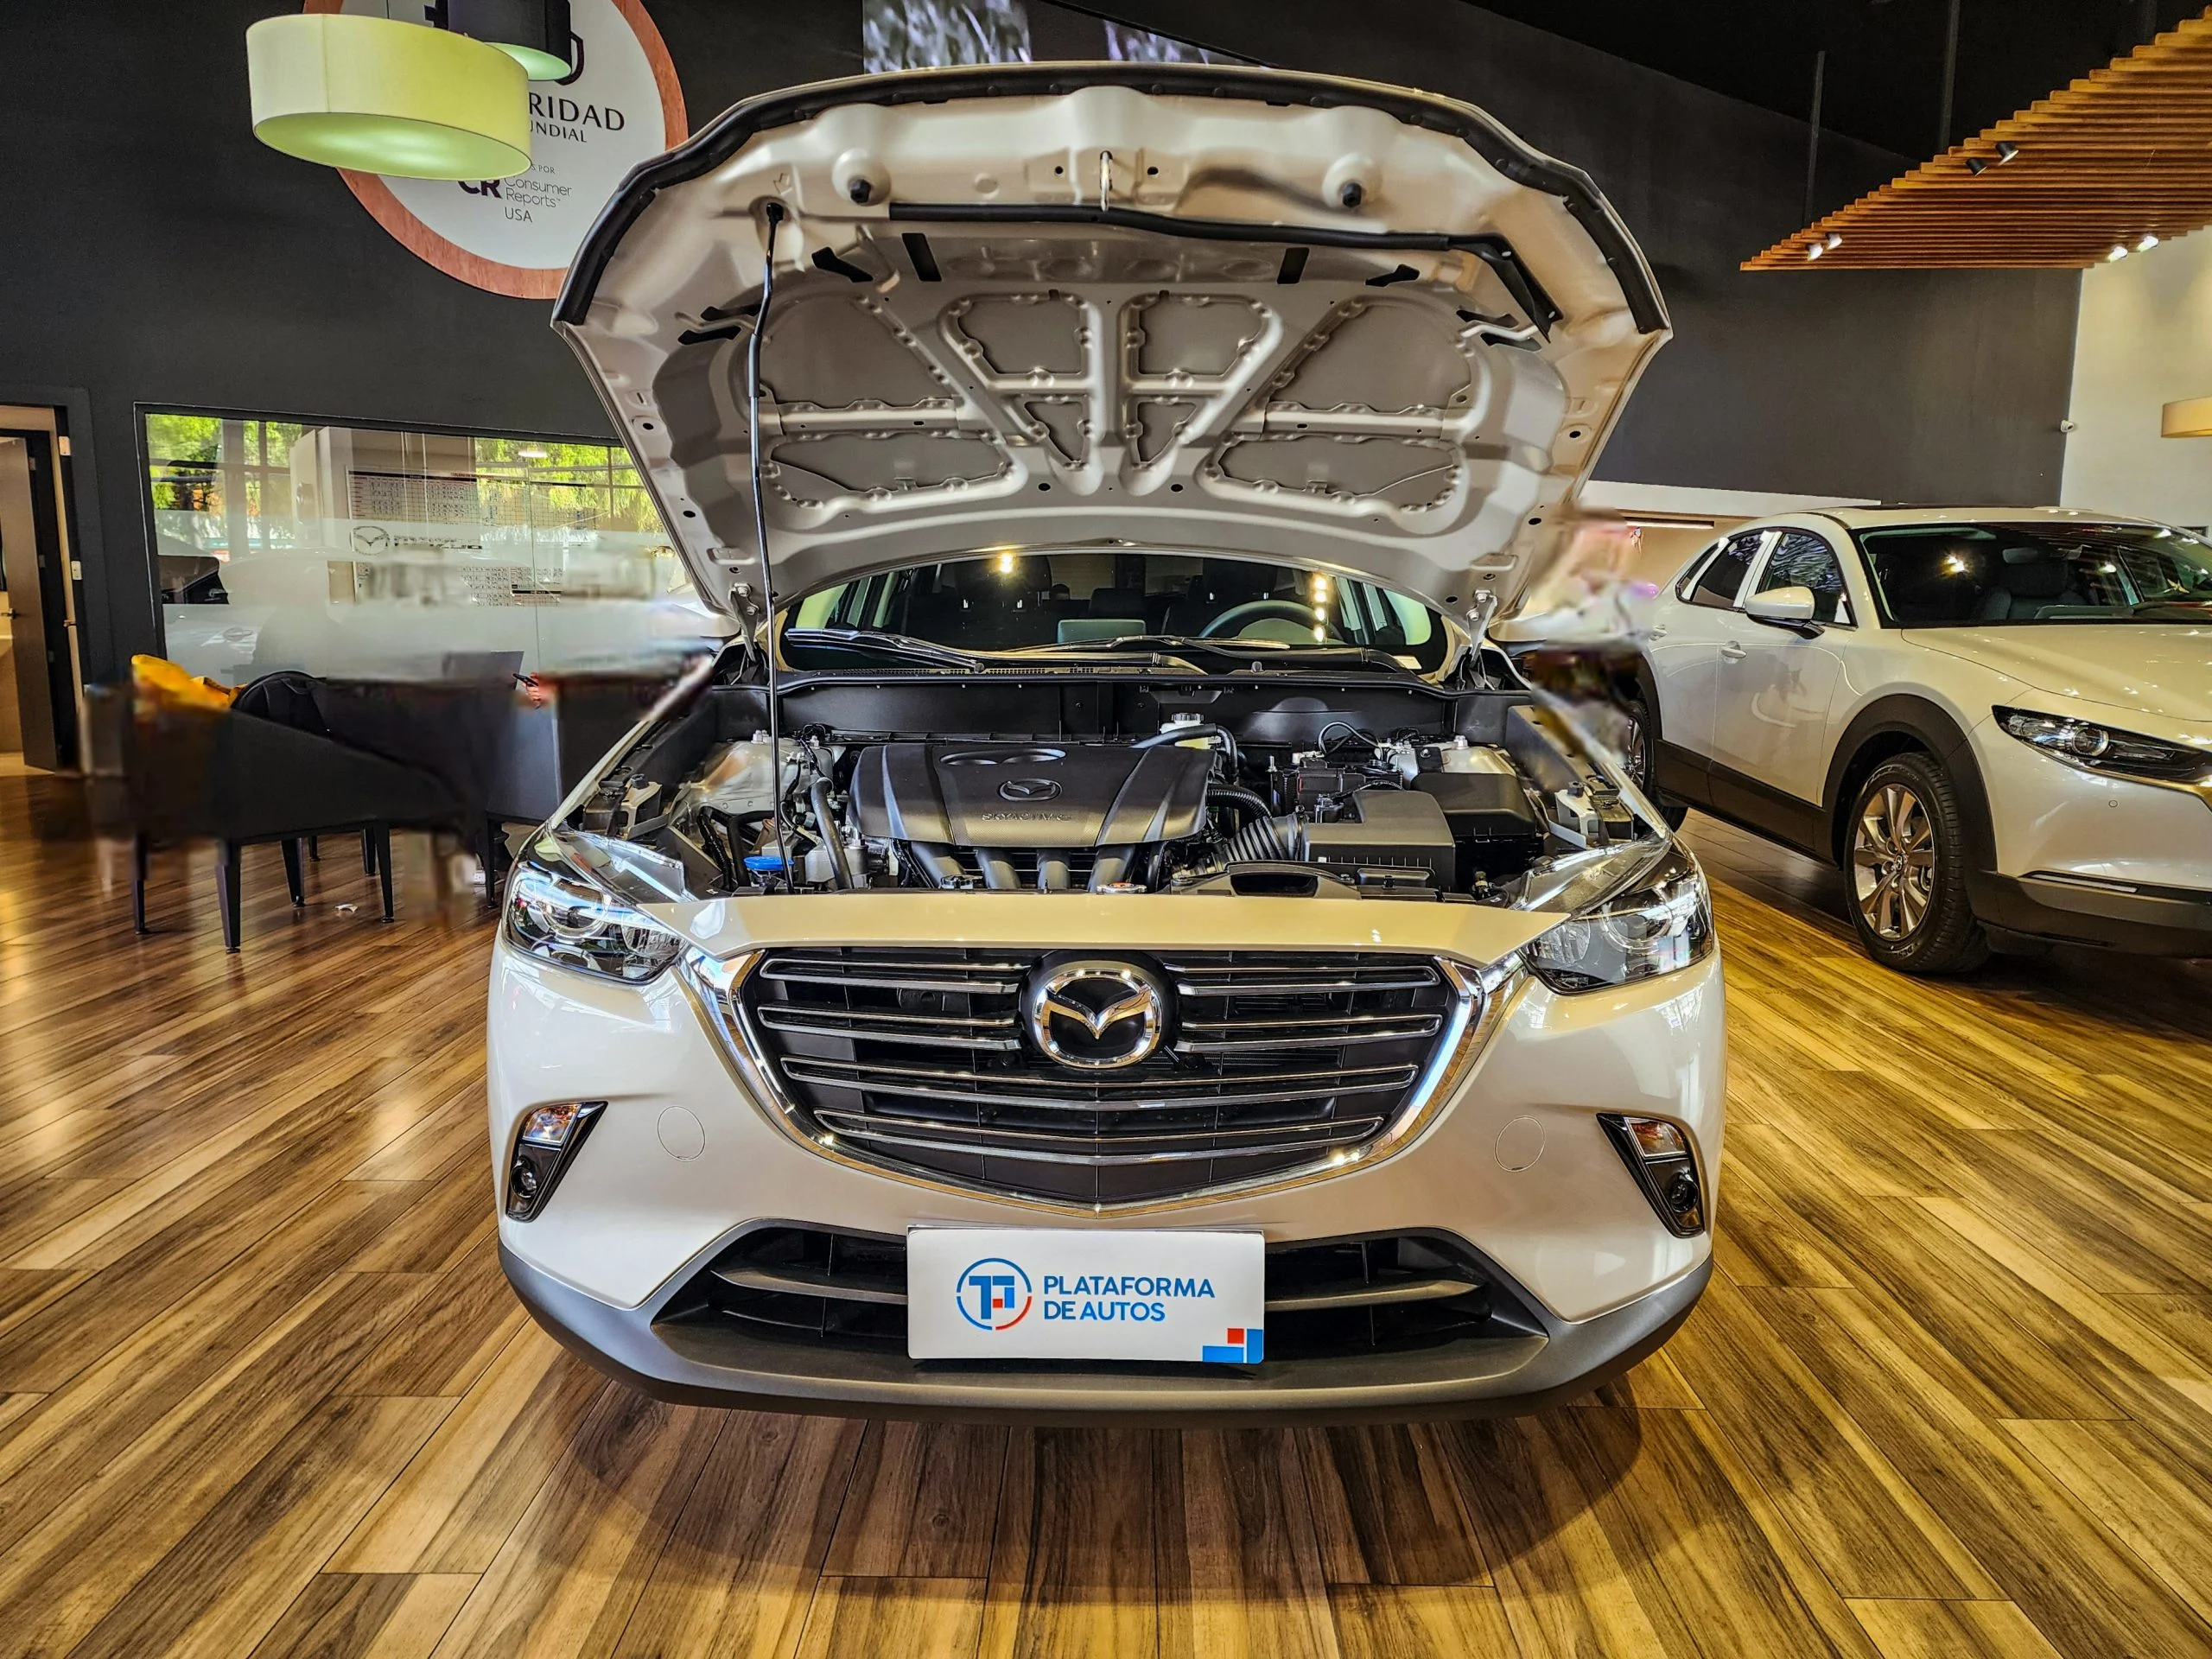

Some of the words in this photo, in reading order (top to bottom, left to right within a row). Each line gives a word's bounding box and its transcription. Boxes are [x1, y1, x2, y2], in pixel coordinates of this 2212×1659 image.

[537, 164, 556, 175] POR
[504, 177, 572, 197] Consumer
[505, 207, 533, 223] USA
[1043, 1275, 1216, 1299] PLATAFORMA
[1043, 1300, 1077, 1320] DE
[1079, 1300, 1166, 1322] AUTOS
